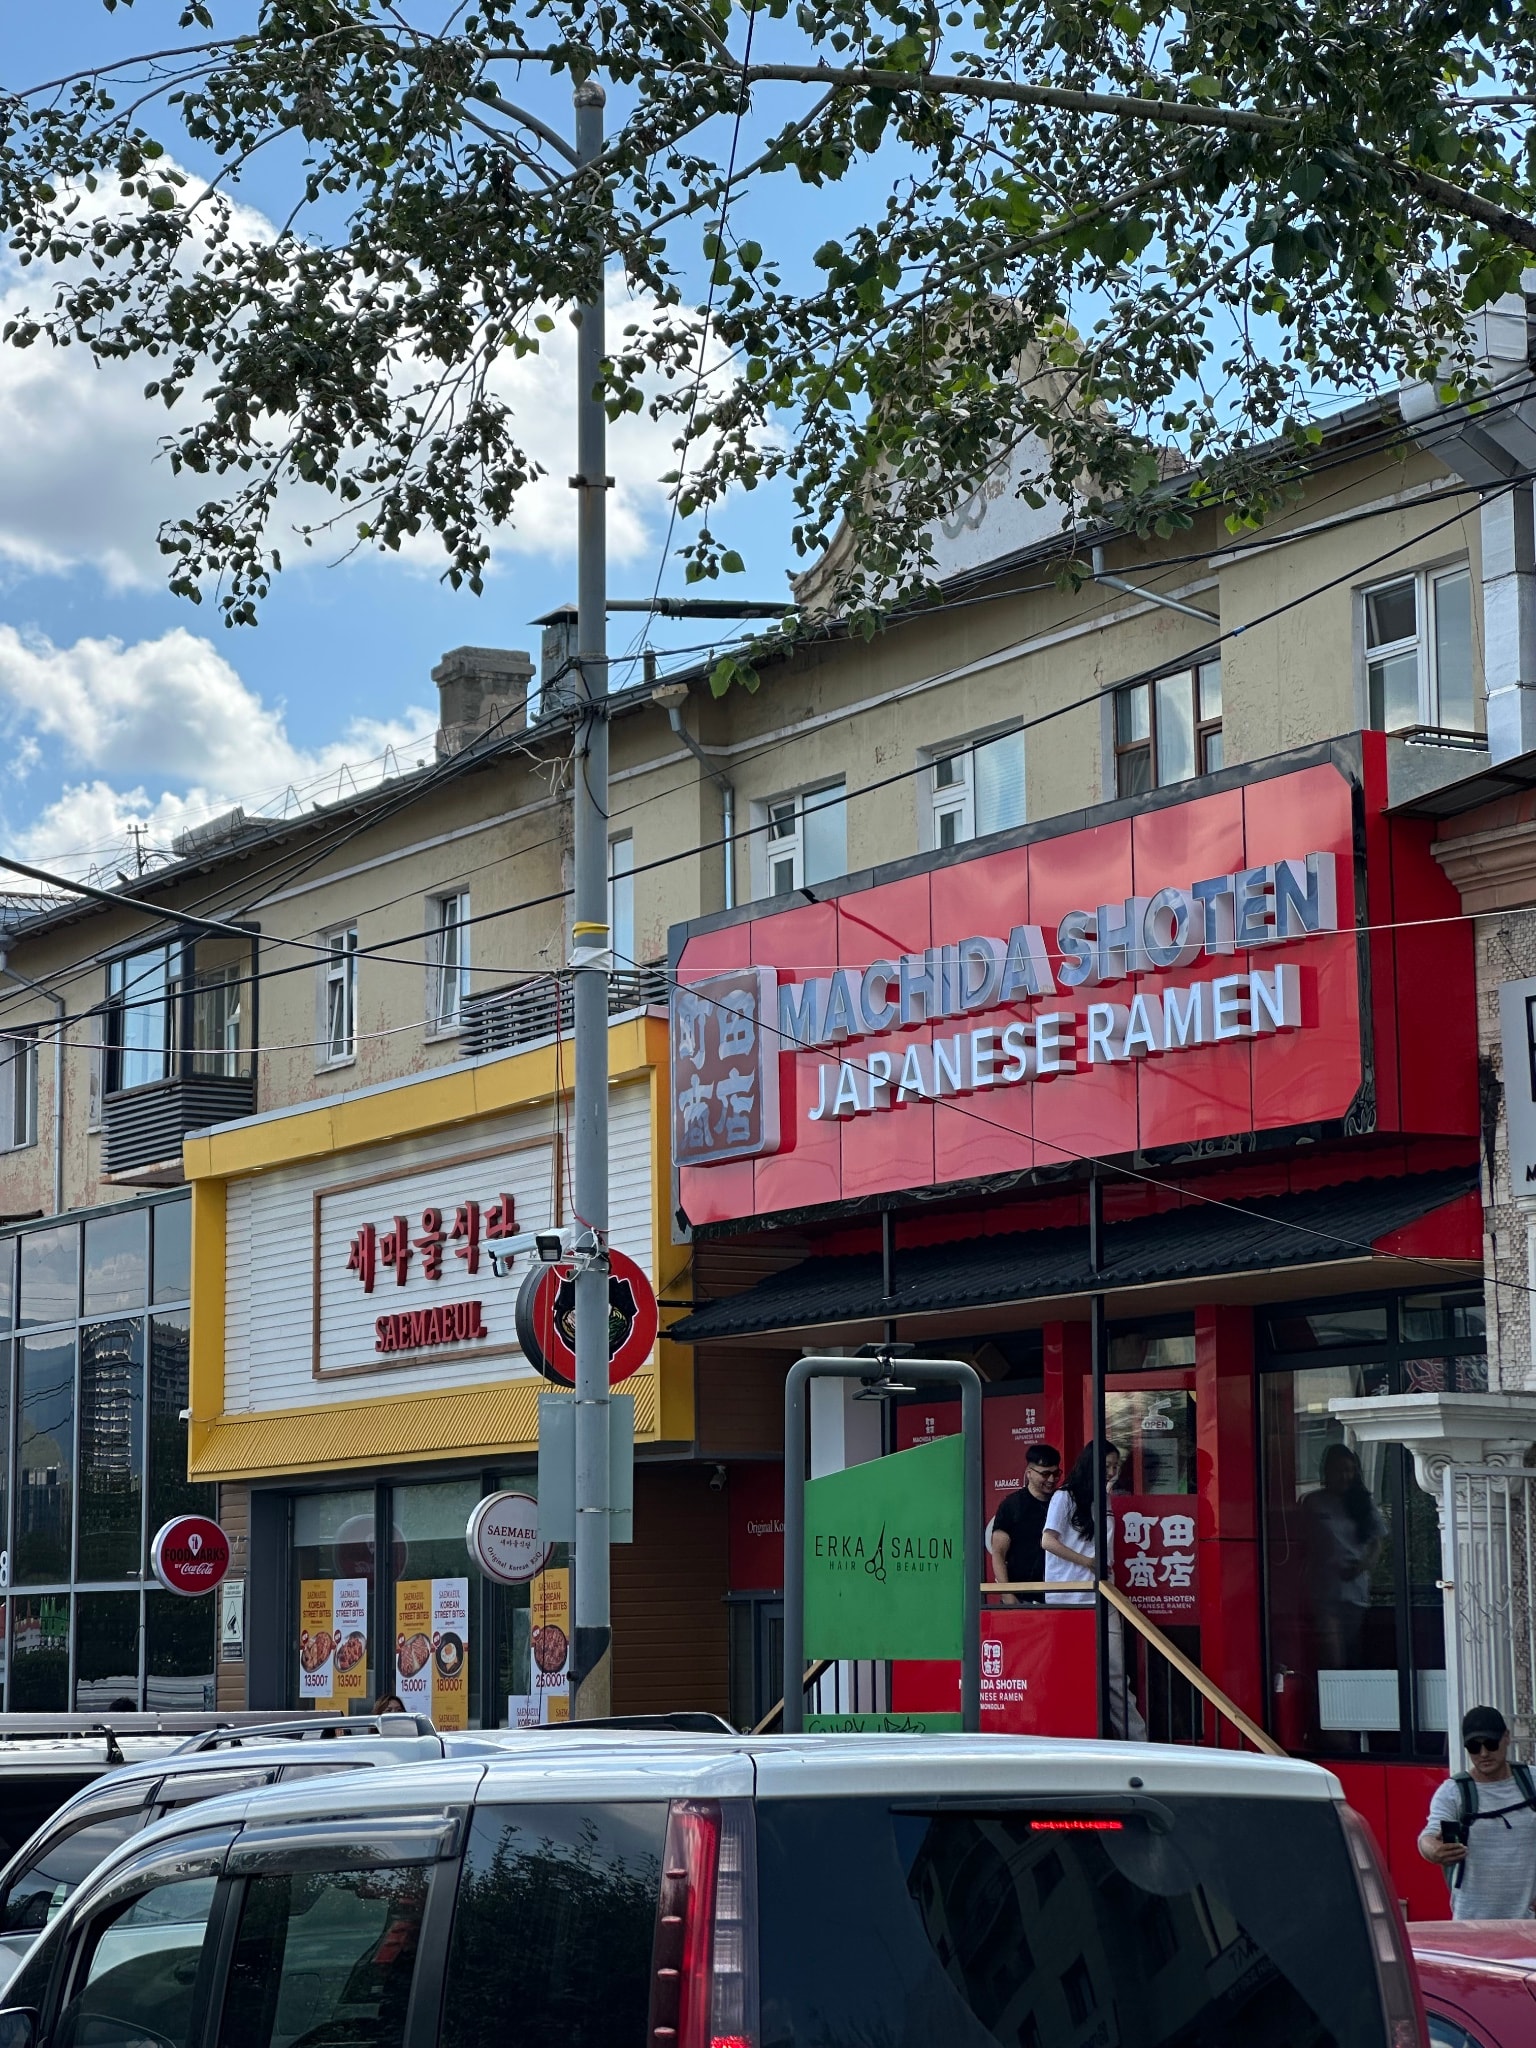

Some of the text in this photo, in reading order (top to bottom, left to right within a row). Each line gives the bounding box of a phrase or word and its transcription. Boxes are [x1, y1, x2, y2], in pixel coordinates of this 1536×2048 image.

[778, 851, 1336, 1051] MACHIDA SHOTEN
[678, 989, 756, 1070] 町田
[808, 963, 1300, 1121] JAPANESE RAMEN
[679, 1067, 756, 1149] 商店
[375, 1301, 488, 1353] SAEMAEUL
[1144, 1421, 1168, 1429] OPEN
[487, 1525, 537, 1540] SAEMAEU
[747, 1519, 773, 1537] Original
[1122, 1511, 1195, 1550] 町田
[164, 1548, 226, 1562] FOODMARKS
[815, 1535, 953, 1559] ERKA SALON
[487, 1546, 508, 1568] Original
[508, 1563, 530, 1571] Korean
[829, 1561, 939, 1572] HAIR BEAUTY
[1124, 1550, 1195, 1588] 商店
[440, 1600, 460, 1609] KOREAN
[1163, 1595, 1196, 1603] SHOTEN
[434, 1609, 466, 1619] STREET BITES
[995, 1679, 1028, 1690] SHOTEN
[999, 1692, 1024, 1702] RAMEN
